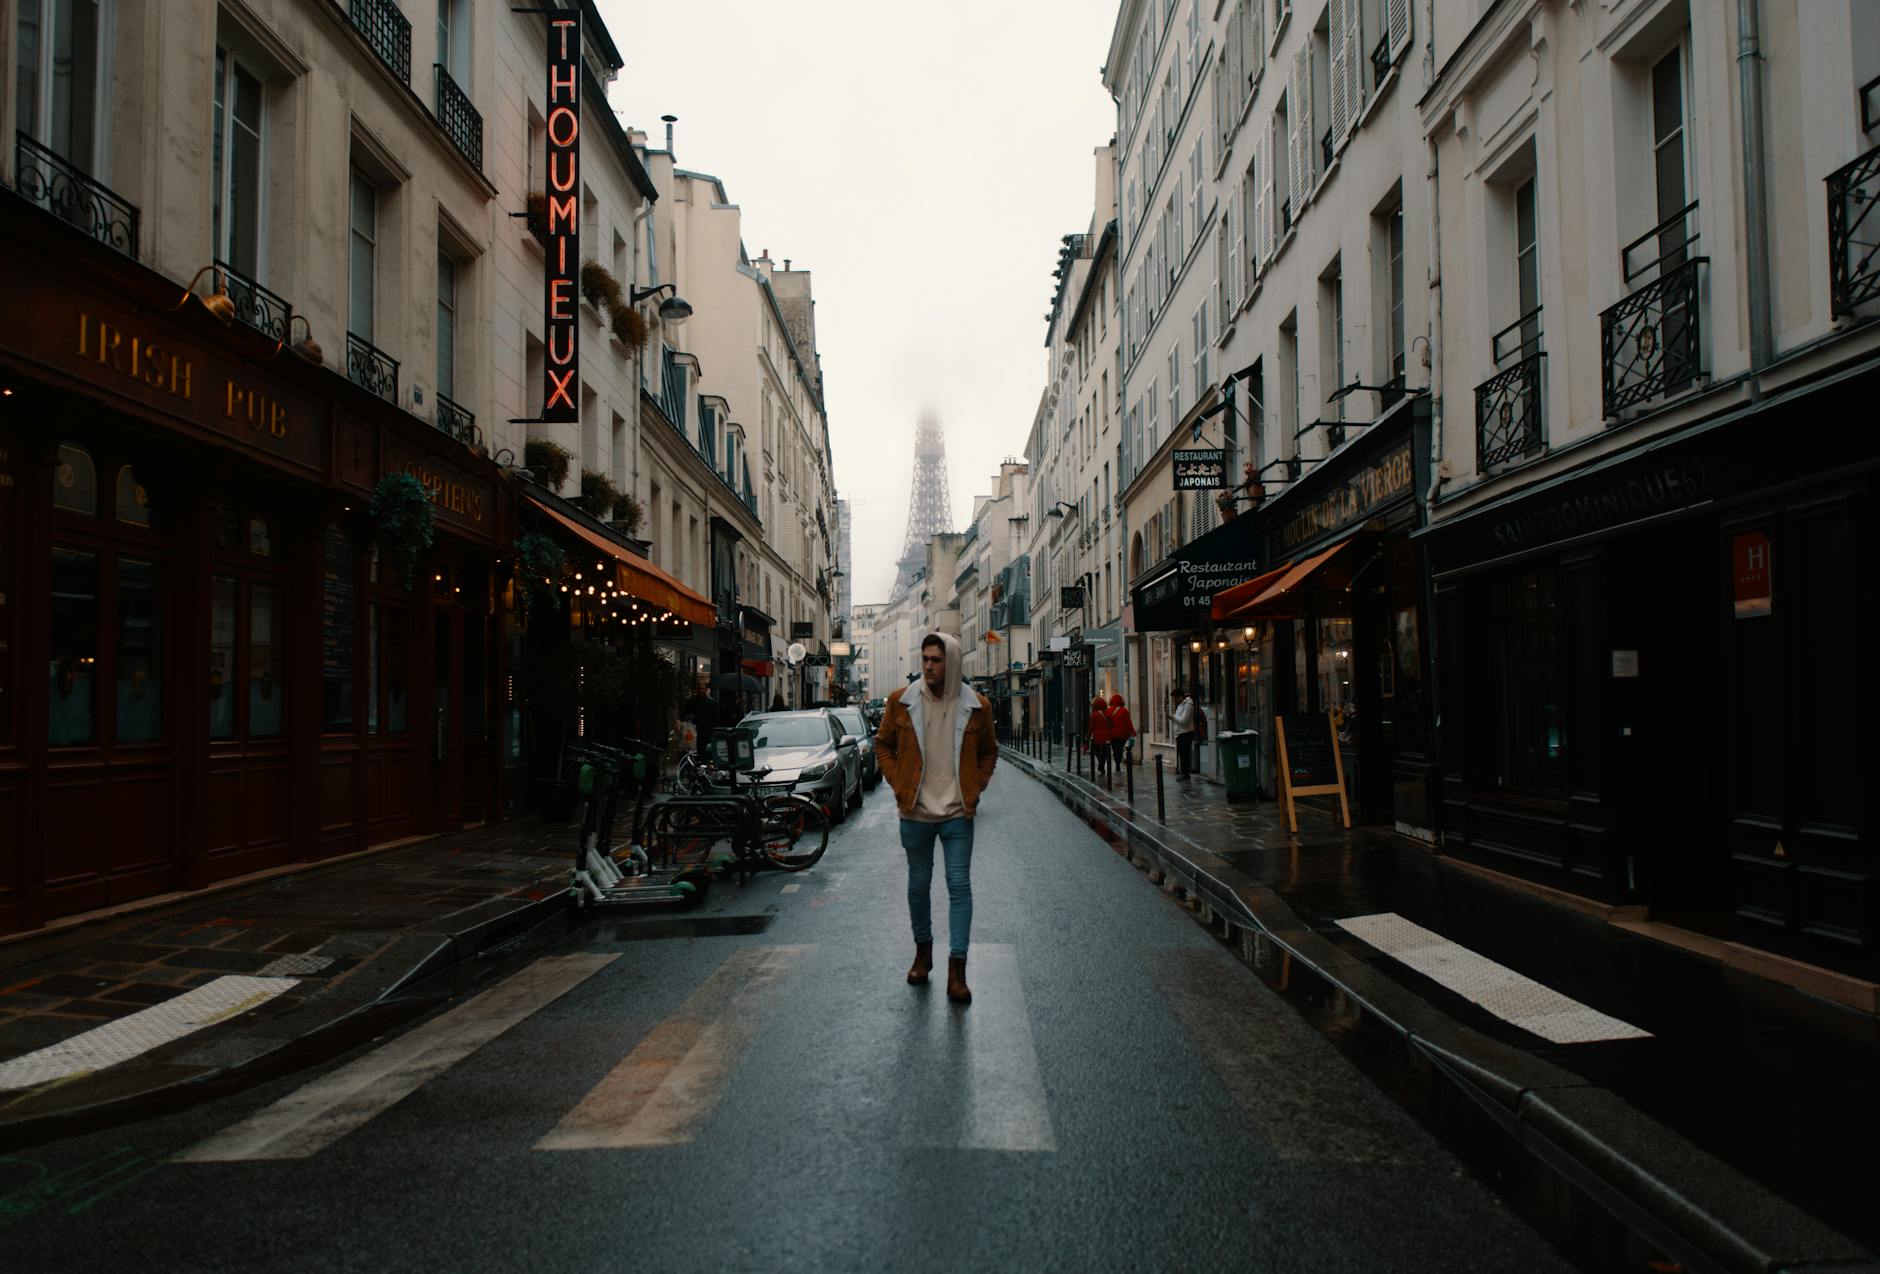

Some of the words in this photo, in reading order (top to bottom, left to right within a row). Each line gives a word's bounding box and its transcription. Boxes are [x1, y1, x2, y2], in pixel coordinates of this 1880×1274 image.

[548, 20, 579, 410] THOUMIEUX
[75, 310, 193, 401] IRISH
[223, 376, 287, 440] PUB
[1174, 451, 1223, 461] RESTAURANT
[1176, 463, 1223, 477] とよたか
[1179, 476, 1220, 487] JAPONAIS
[1322, 495, 1337, 529] DE
[1340, 486, 1359, 521] LA
[1360, 453, 1412, 507] VIERGE
[1747, 544, 1764, 571] H
[1179, 559, 1257, 574] Restaurant
[1183, 596, 1195, 606] 01
[1198, 595, 1211, 606] 45
